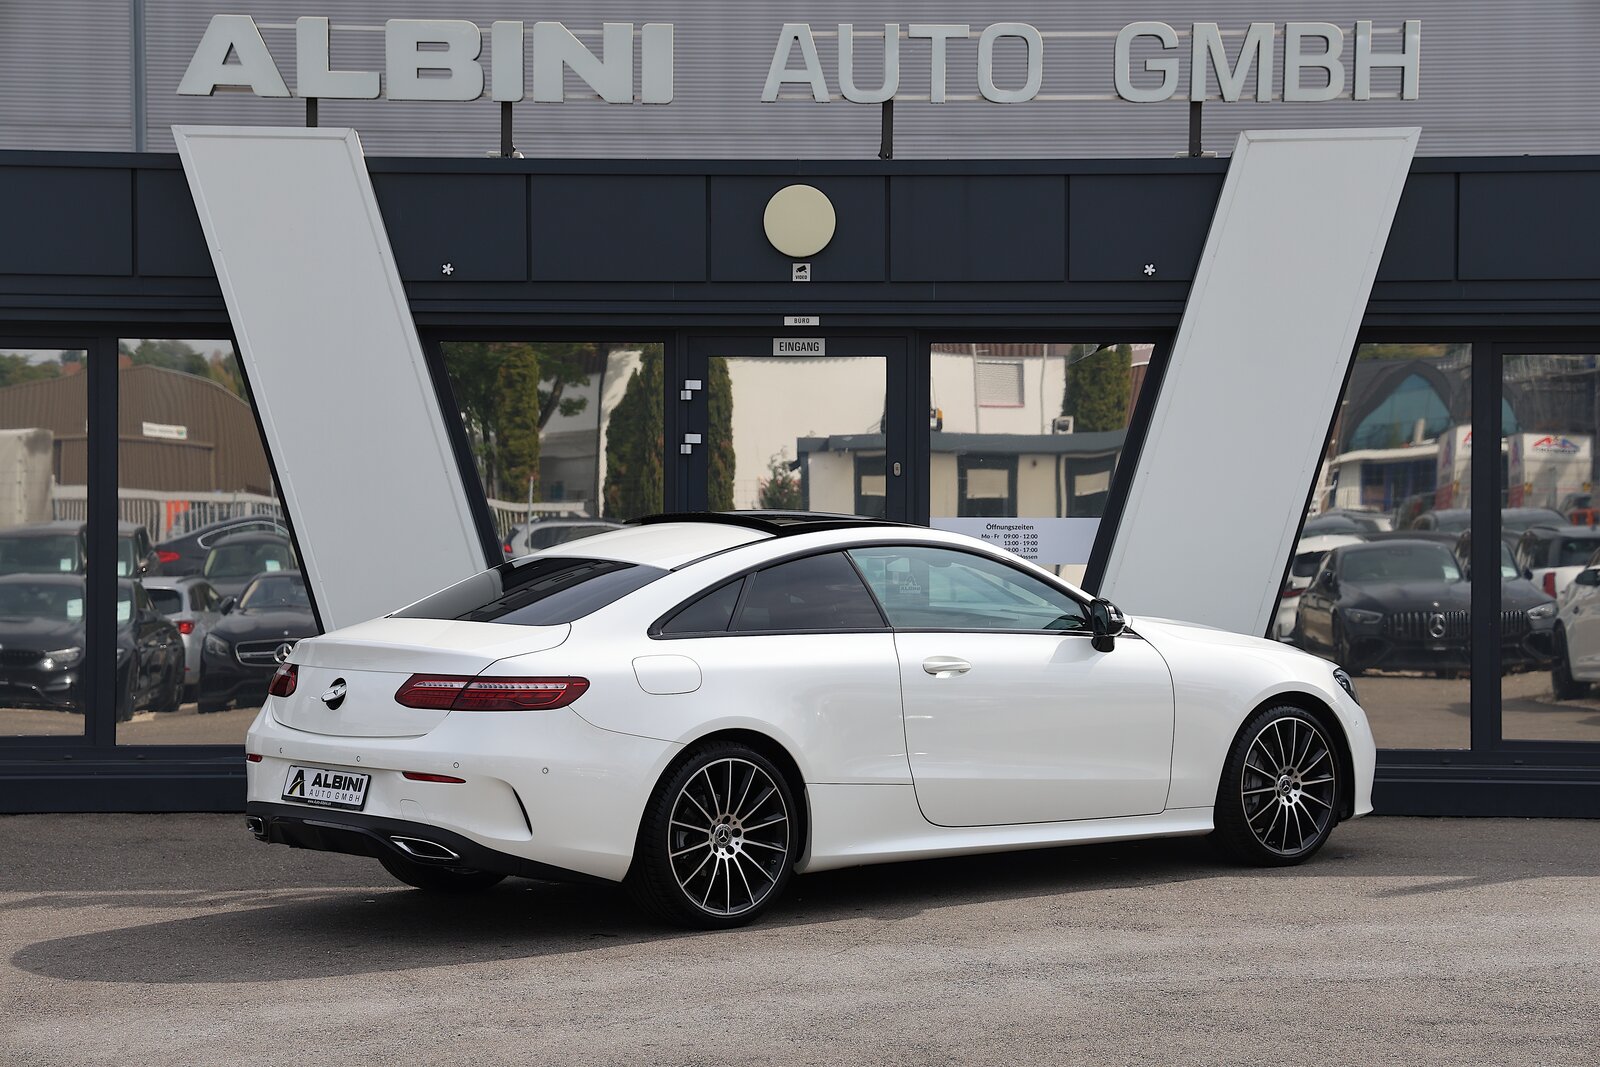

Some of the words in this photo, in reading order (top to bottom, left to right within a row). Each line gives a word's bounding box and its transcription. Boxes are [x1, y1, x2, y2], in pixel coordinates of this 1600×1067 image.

[176, 14, 674, 104] ALBINI
[761, 22, 1044, 104] AUTO
[1114, 20, 1421, 103] GMBH
[779, 341, 820, 352] EINGANG
[986, 523, 1034, 531] Öffnungszeiten
[311, 772, 364, 792] ALBINI
[309, 789, 332, 799] AUTO
[335, 791, 361, 802] GMBH
